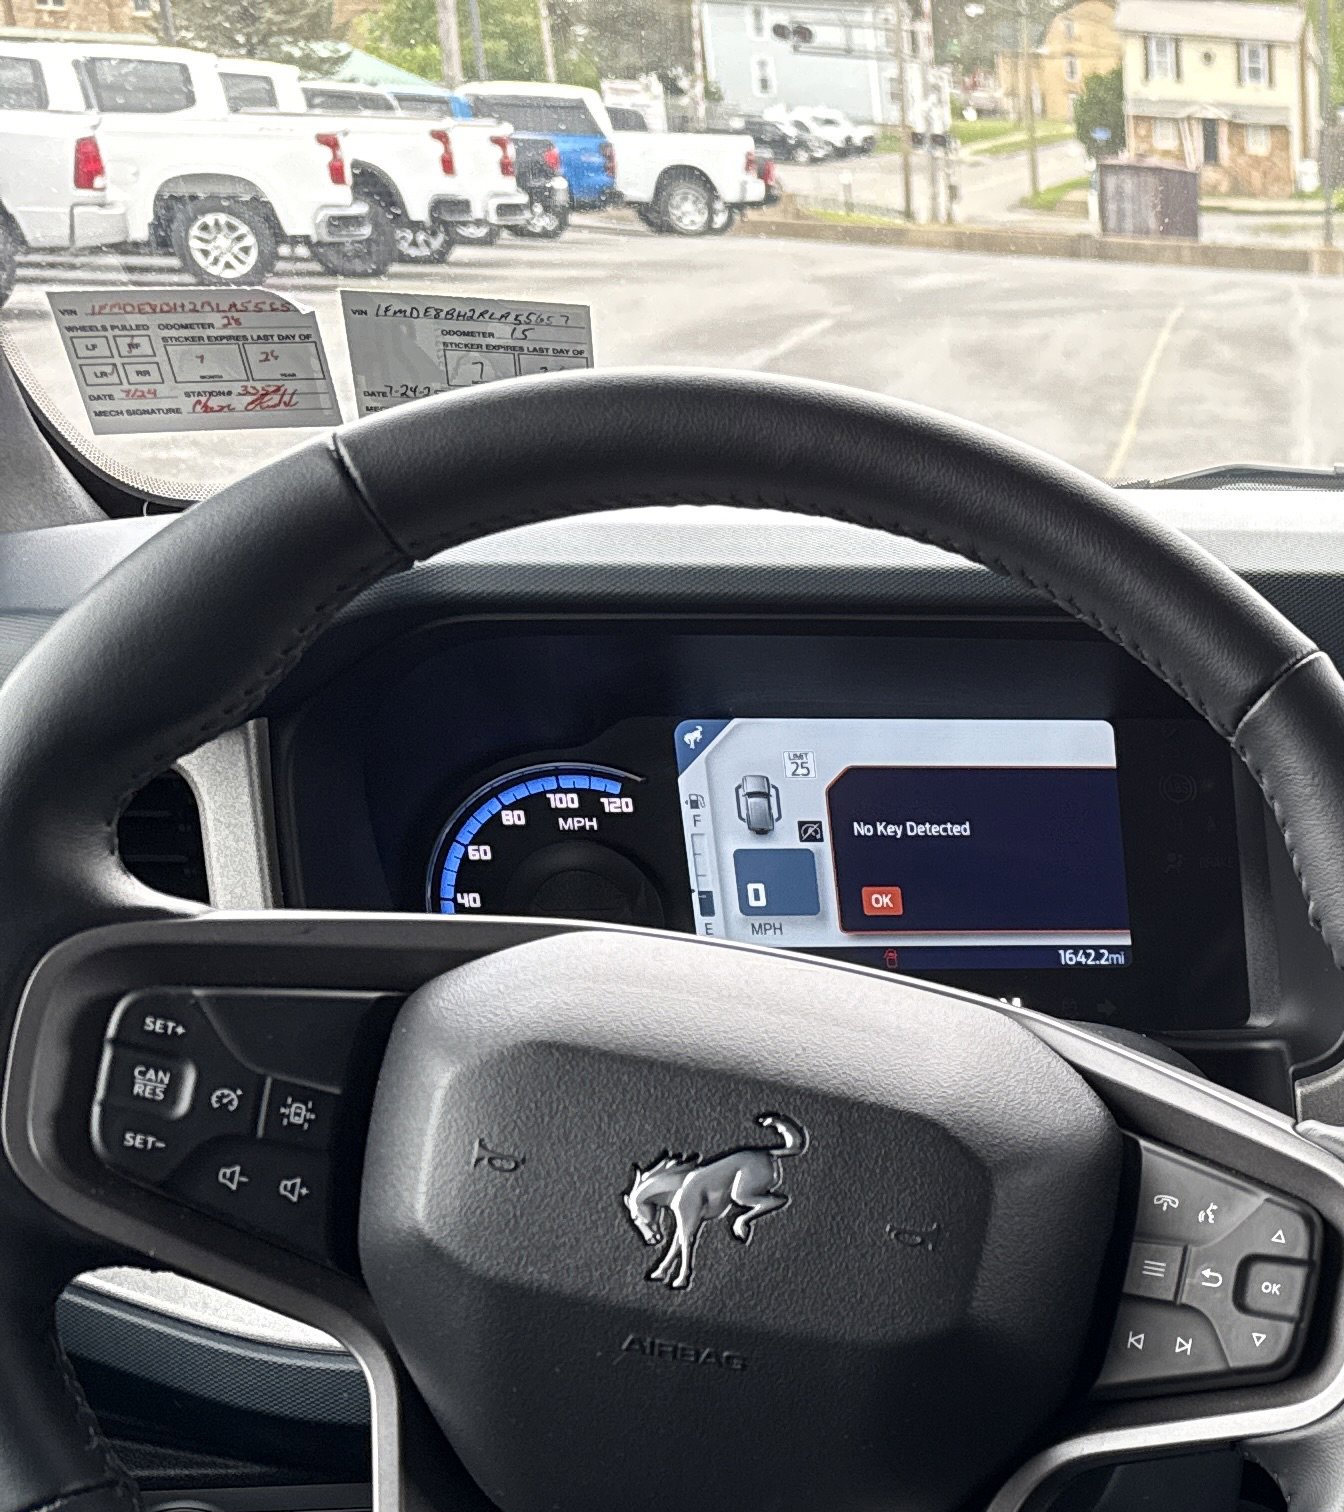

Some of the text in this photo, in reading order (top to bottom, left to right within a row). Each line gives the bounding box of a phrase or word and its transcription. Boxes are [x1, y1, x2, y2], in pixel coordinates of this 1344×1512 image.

[351, 308, 368, 316] VIN
[64, 324, 109, 333] WHEELS
[110, 323, 150, 332] PULLED
[158, 322, 215, 331] ODOMETER
[441, 329, 495, 340] ODOMETER
[161, 333, 312, 343] STICKER EXPIRES LAST DAY OF
[442, 341, 483, 351] STICKER
[486, 343, 525, 353] EXPIRES
[527, 346, 549, 354] LAST
[552, 348, 571, 356] DAY
[136, 370, 150, 378] RR
[363, 390, 388, 398] DATE
[94, 407, 183, 418] MECH SIGNATURE
[791, 761, 811, 777] 25
[546, 793, 580, 809] 100
[600, 797, 634, 813] 120
[501, 809, 526, 825] 80
[558, 817, 599, 831] MPH
[693, 815, 702, 828] F
[853, 821, 971, 839] No Key Detected
[467, 845, 492, 861] 60
[456, 892, 482, 909] 40
[747, 883, 767, 908] 0
[871, 893, 894, 908] OK
[704, 923, 713, 936] E
[751, 922, 784, 936] MPH
[133, 1065, 170, 1085] CAN
[133, 1083, 165, 1101] RES
[1261, 1281, 1281, 1296] OK
[621, 1333, 748, 1370] AIRBAG
